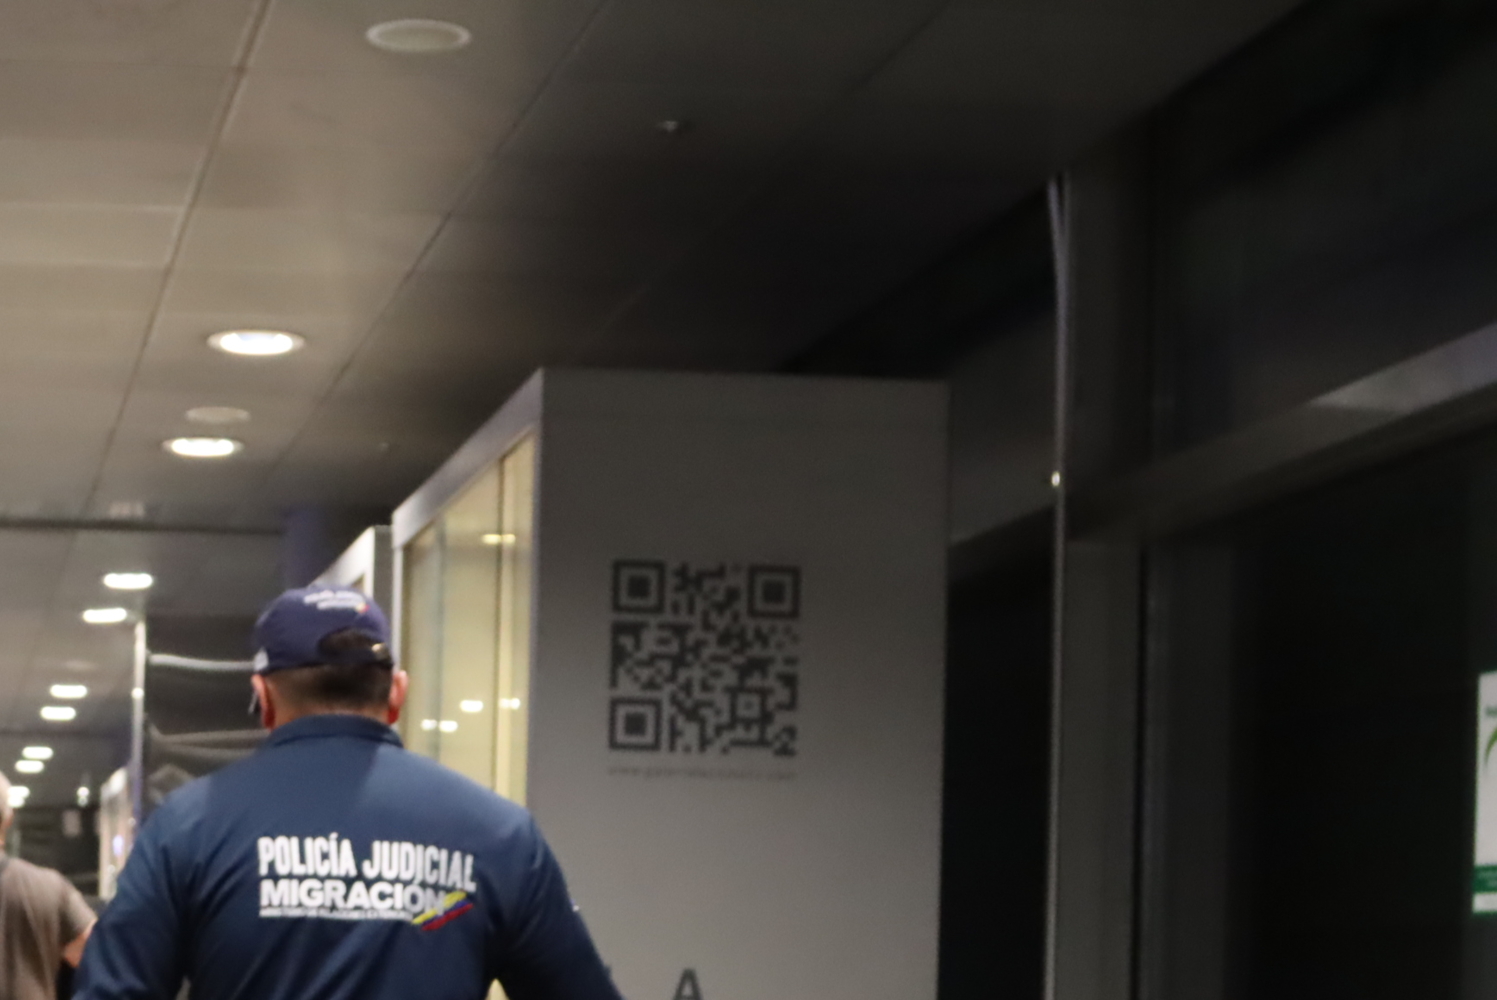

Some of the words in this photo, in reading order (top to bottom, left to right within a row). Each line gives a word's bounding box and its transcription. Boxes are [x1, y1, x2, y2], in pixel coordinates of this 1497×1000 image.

[257, 832, 357, 877] POLICÍA
[362, 840, 477, 893] JUDICIAL
[260, 877, 448, 916] MIGRACIÓN
